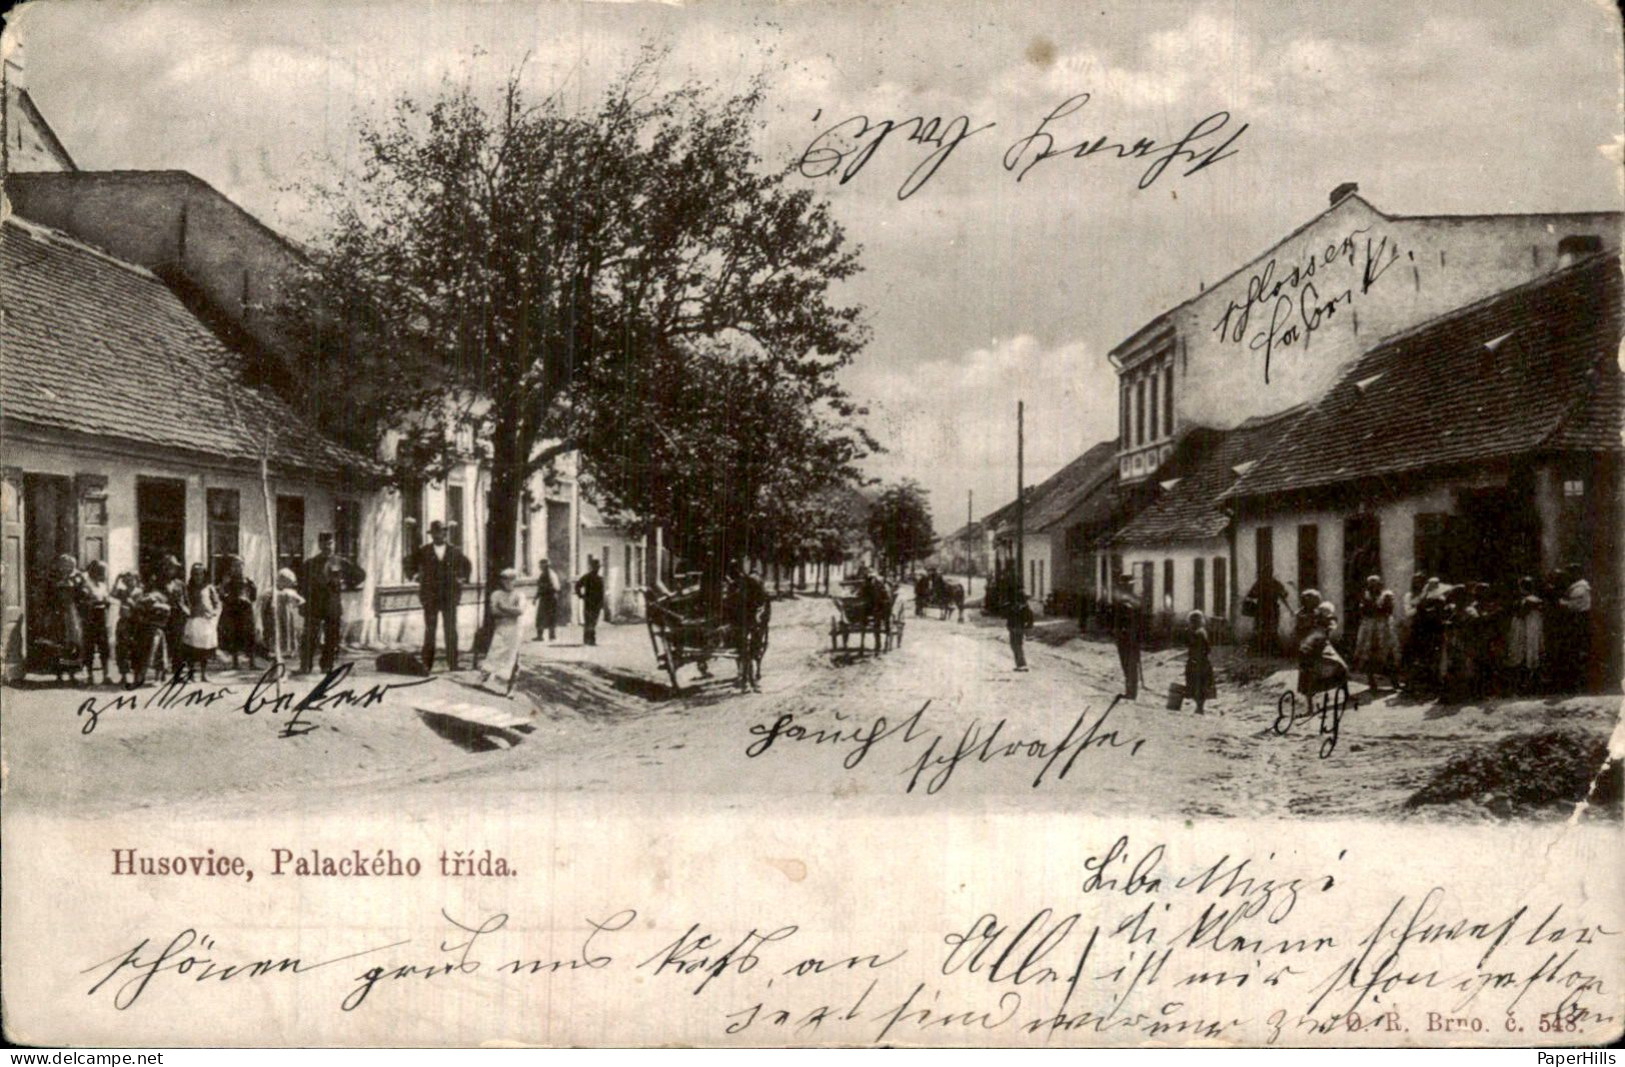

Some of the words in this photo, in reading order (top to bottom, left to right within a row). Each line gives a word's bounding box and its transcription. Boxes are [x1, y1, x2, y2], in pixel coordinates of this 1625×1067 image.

[111, 848, 254, 882] Husovice,
[271, 848, 421, 877] Palackého
[440, 849, 518, 877] třída.
[1384, 1011, 1409, 1033] R.
[1426, 1011, 1490, 1033] Brno.
[1504, 1009, 1525, 1033] č.
[1538, 1011, 1585, 1034] 548.
